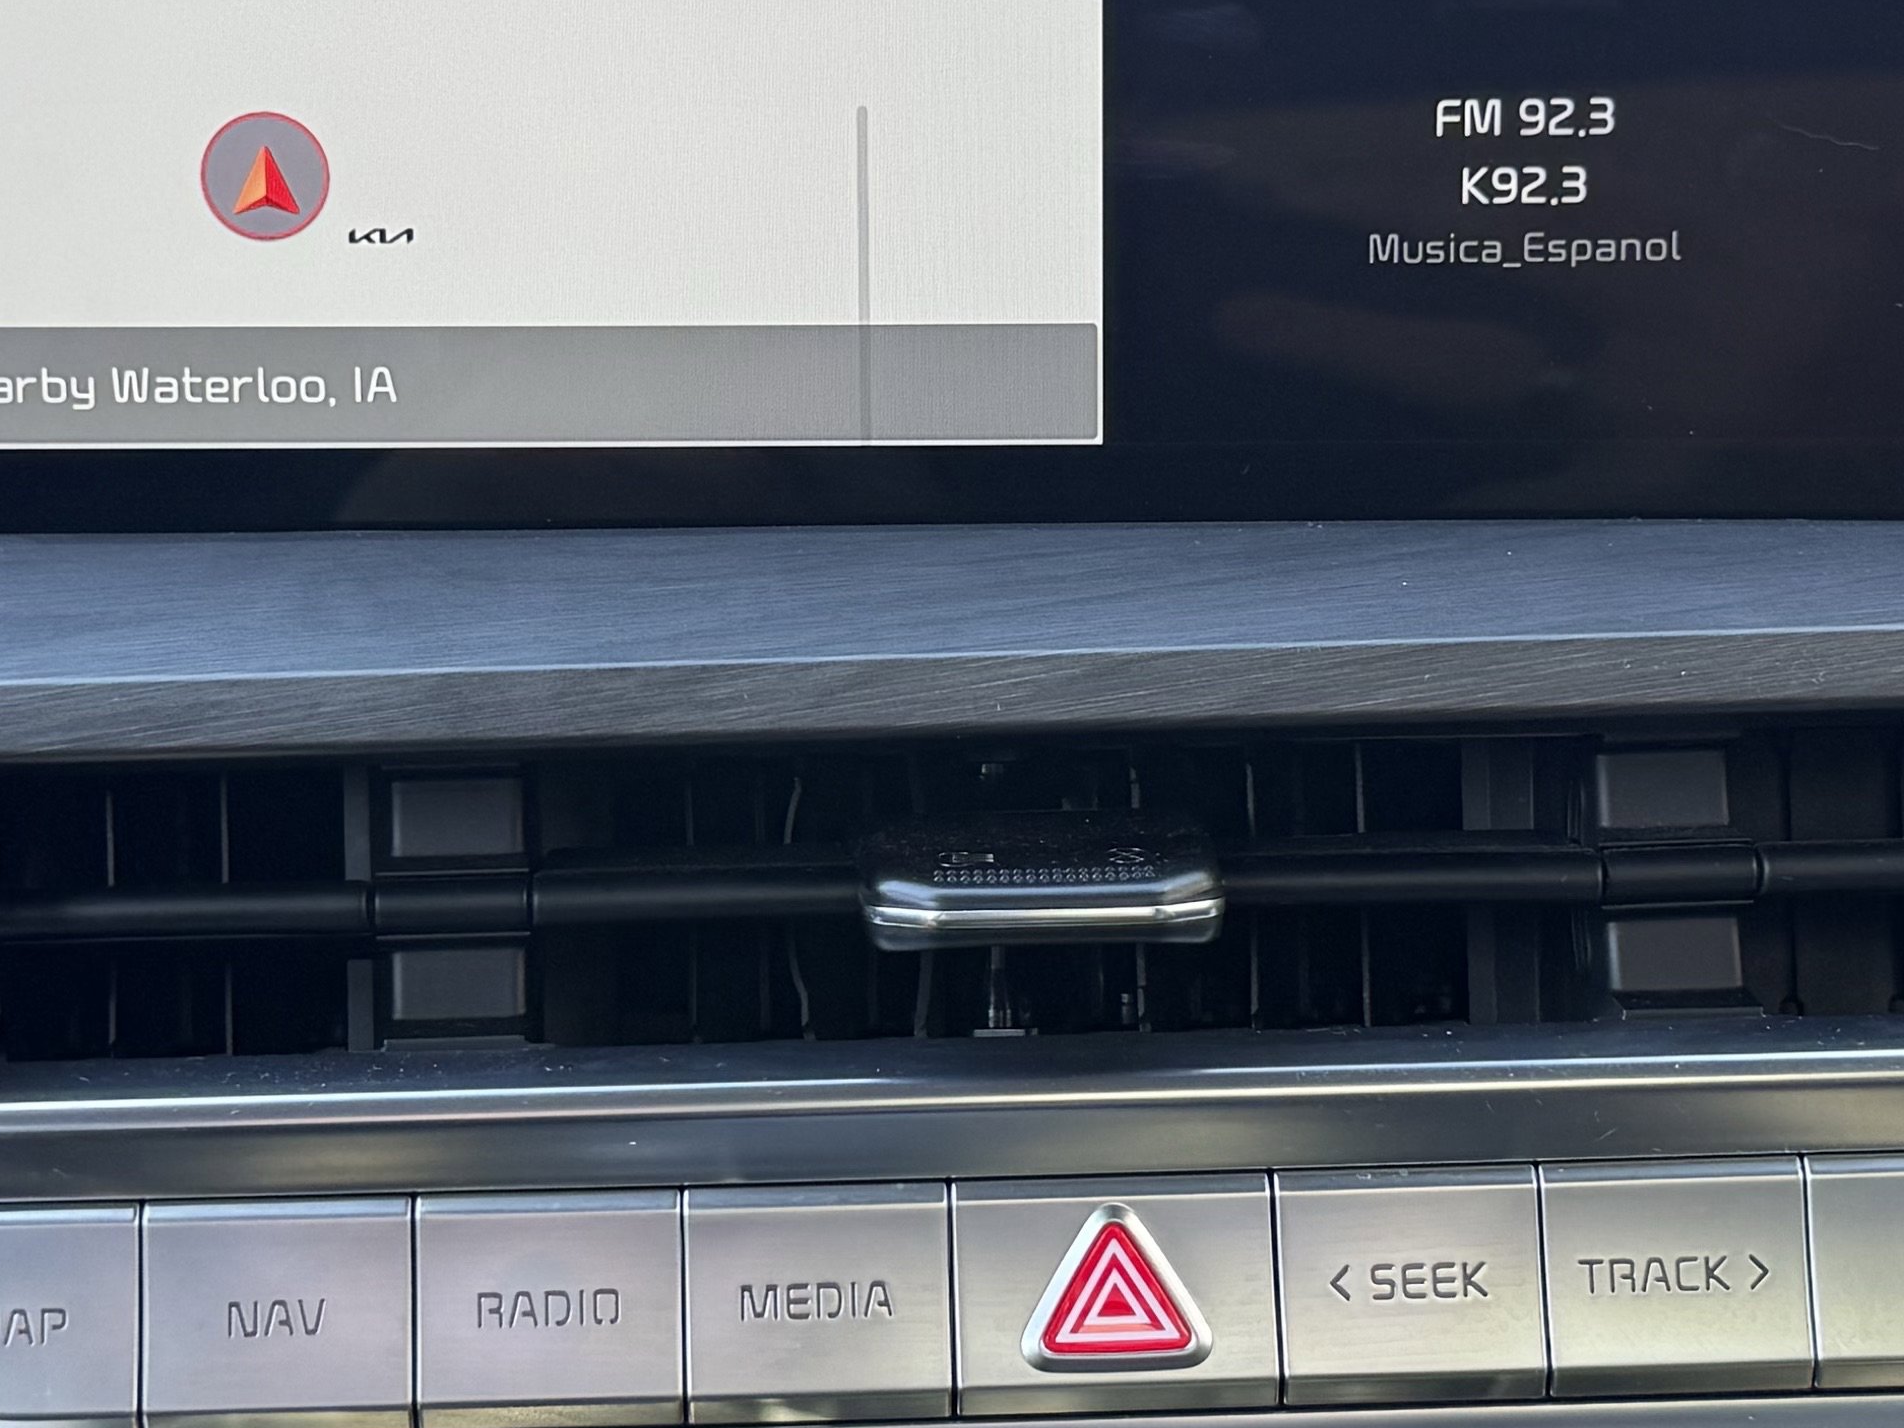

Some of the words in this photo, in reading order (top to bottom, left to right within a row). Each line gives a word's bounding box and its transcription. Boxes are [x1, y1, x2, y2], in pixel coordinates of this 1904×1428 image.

[1435, 99, 1502, 138] FM
[1518, 97, 1616, 137] 92.3
[1460, 167, 1588, 206] K92.3
[1368, 231, 1682, 269] Musica_Espanol
[111, 367, 338, 410] Waterloo,
[353, 367, 398, 404] IA
[1369, 1260, 1489, 1302] SEEK
[1578, 1254, 1730, 1295] TRACK
[227, 1298, 326, 1340] NAV
[475, 1287, 623, 1330] RADIO
[739, 1281, 896, 1322] MEDIA
